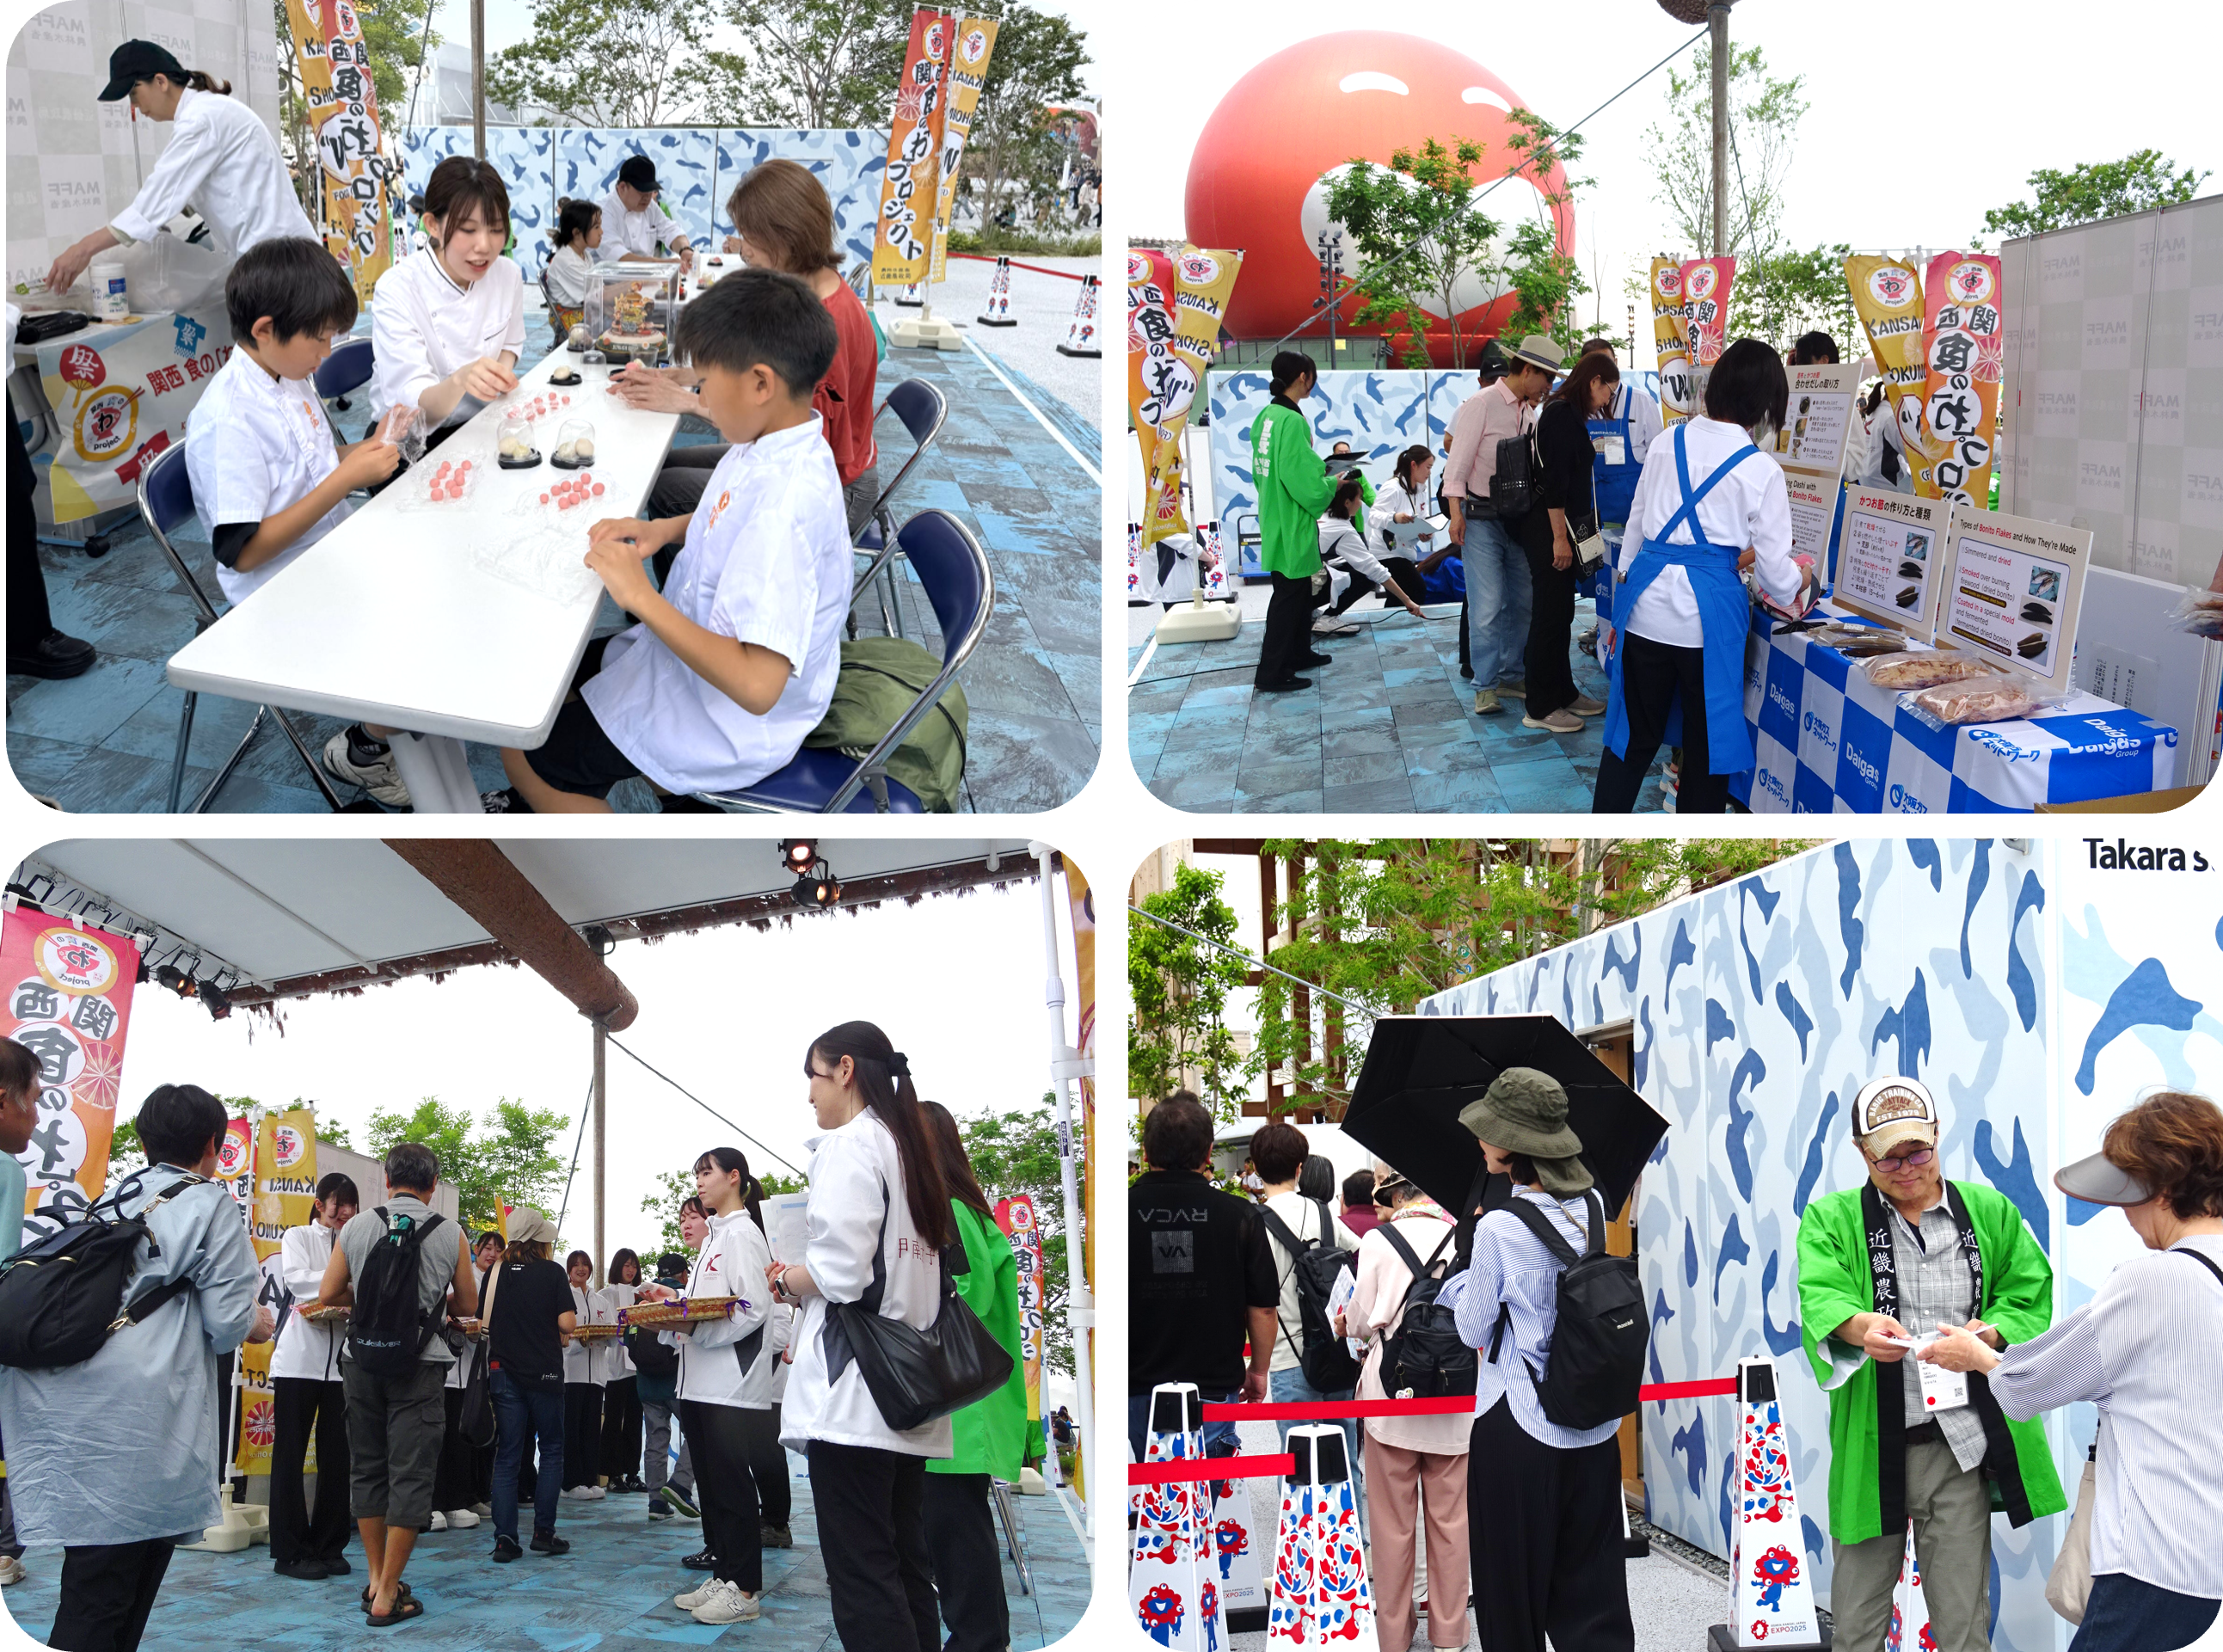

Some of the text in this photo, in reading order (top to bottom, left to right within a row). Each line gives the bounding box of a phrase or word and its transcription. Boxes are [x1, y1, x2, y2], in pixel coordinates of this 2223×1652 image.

[1665, 277, 1675, 286] わ
[1885, 279, 1900, 292] わ
[69, 346, 99, 381] 祭
[146, 363, 184, 396] 関西
[1796, 378, 1839, 389] 合わせだしの取り方
[98, 413, 114, 432] わ
[94, 436, 121, 451] project
[1793, 480, 1805, 489] Dashi
[1808, 493, 1822, 504] Flakes
[1859, 495, 1931, 521] かつお節の作り方と種類
[1960, 519, 1972, 530] Types
[1979, 524, 1995, 535] Bonito
[1995, 528, 2011, 539] Flakes
[2012, 532, 2023, 542] and
[2024, 534, 2036, 545] How
[2059, 543, 2077, 555] Made
[1965, 547, 2011, 566] Simmered and dried
[1962, 566, 2010, 590] Smoked over burning
[1960, 577, 1980, 589] firewood
[1981, 583, 1996, 595] (dried
[1996, 588, 2016, 602] bonito)
[1956, 607, 1988, 625] and fermented
[1957, 597, 1973, 610] Coated
[1974, 602, 1979, 611] in
[1984, 606, 2000, 620] special
[2001, 615, 2014, 624] mold
[1955, 617, 1979, 634] (fermented
[1980, 627, 1993, 639] dried
[1993, 631, 2011, 647] bonito)
[1770, 682, 1795, 715] Daigas
[1784, 709, 1794, 722] Group
[1814, 716, 1830, 737] 大阪ガス
[1813, 727, 1837, 752] ネットワーク
[1846, 741, 1879, 783] Daigas
[1768, 774, 1784, 793] 大阪ガス
[1864, 777, 1878, 791] Group
[1766, 783, 1790, 808] ネットワーク
[2083, 838, 2215, 872] Takara s
[1869, 1096, 1884, 1116] BASIC
[1882, 1088, 1915, 1102] TRAINING
[1914, 1098, 1924, 1108] CA
[1887, 1096, 1912, 1107] ATTACK
[223, 1165, 237, 1174] project
[1138, 1207, 1207, 1223] RVCA
[1771, 1624, 1807, 1634] EXPO2025
